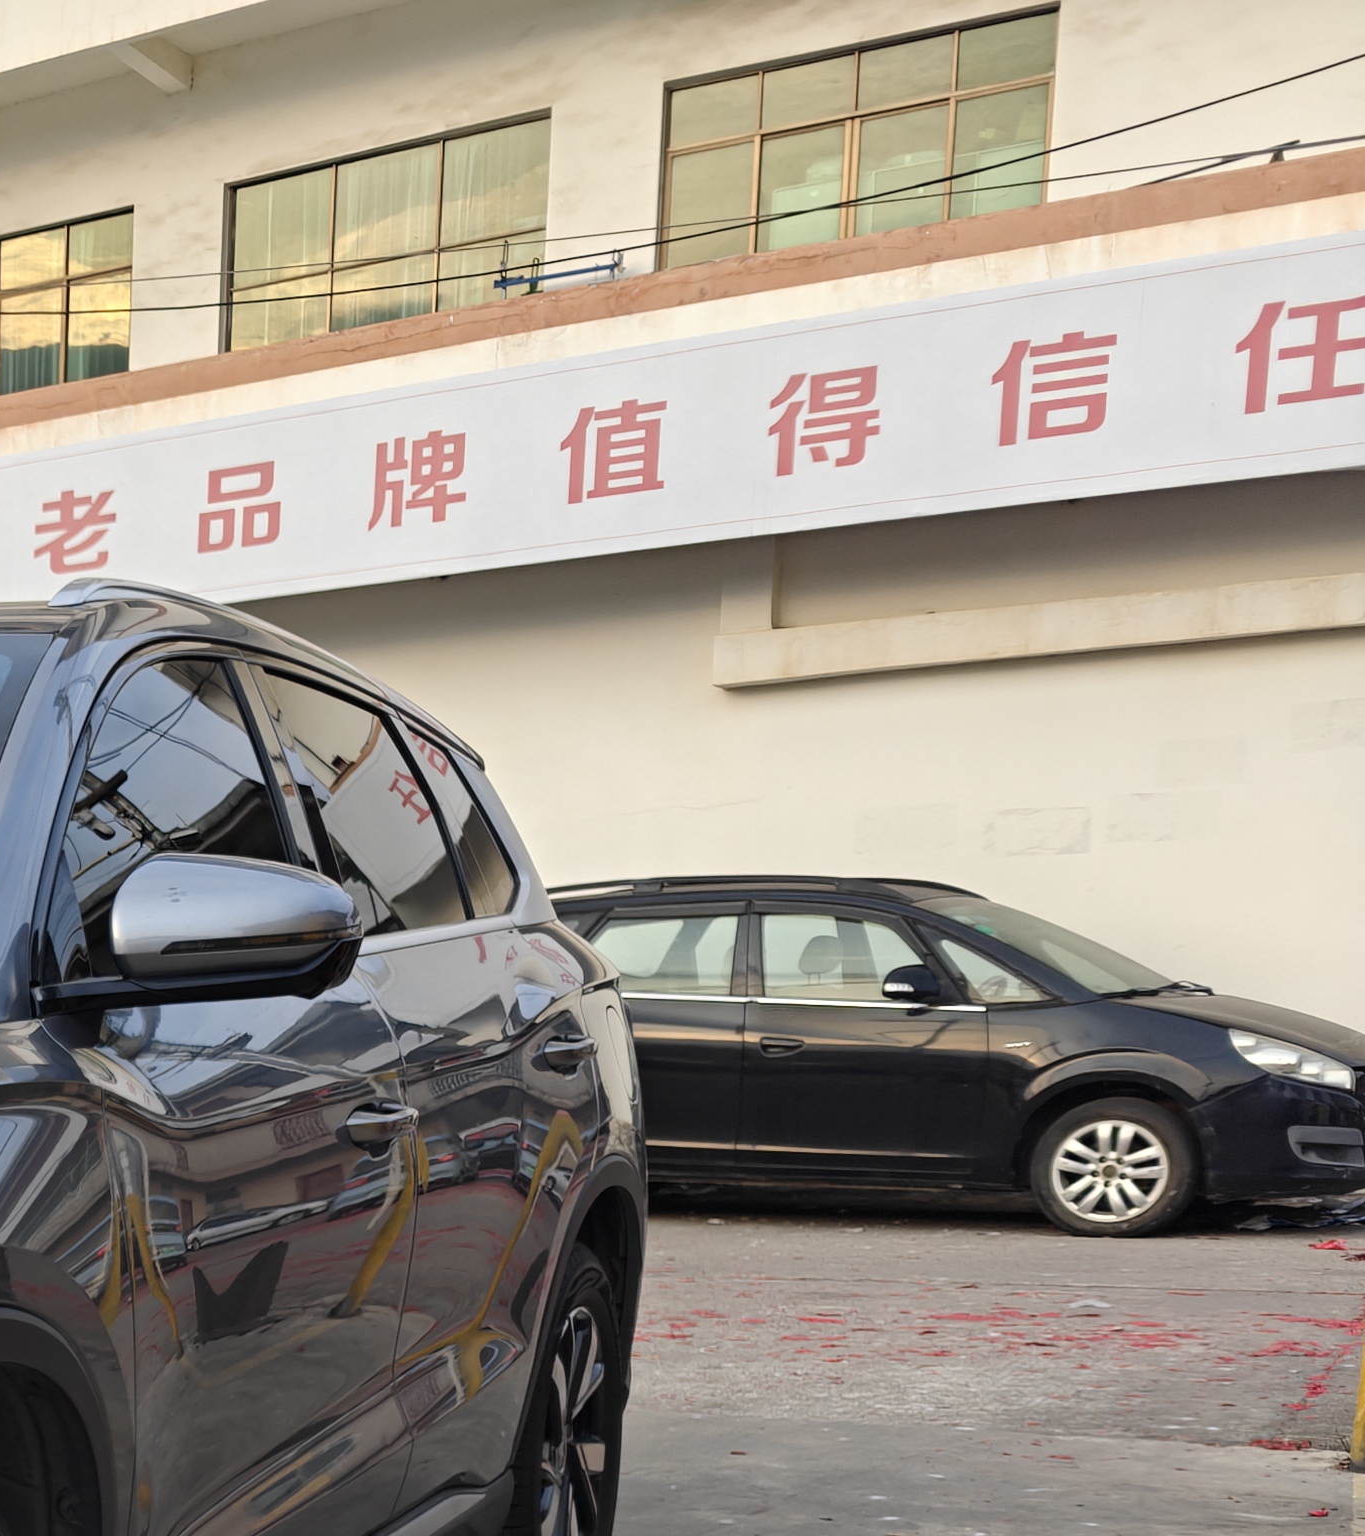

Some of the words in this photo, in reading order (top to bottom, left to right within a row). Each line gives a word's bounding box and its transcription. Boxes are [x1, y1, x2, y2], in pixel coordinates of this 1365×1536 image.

[33, 295, 1365, 575] 老品牌值得信任
